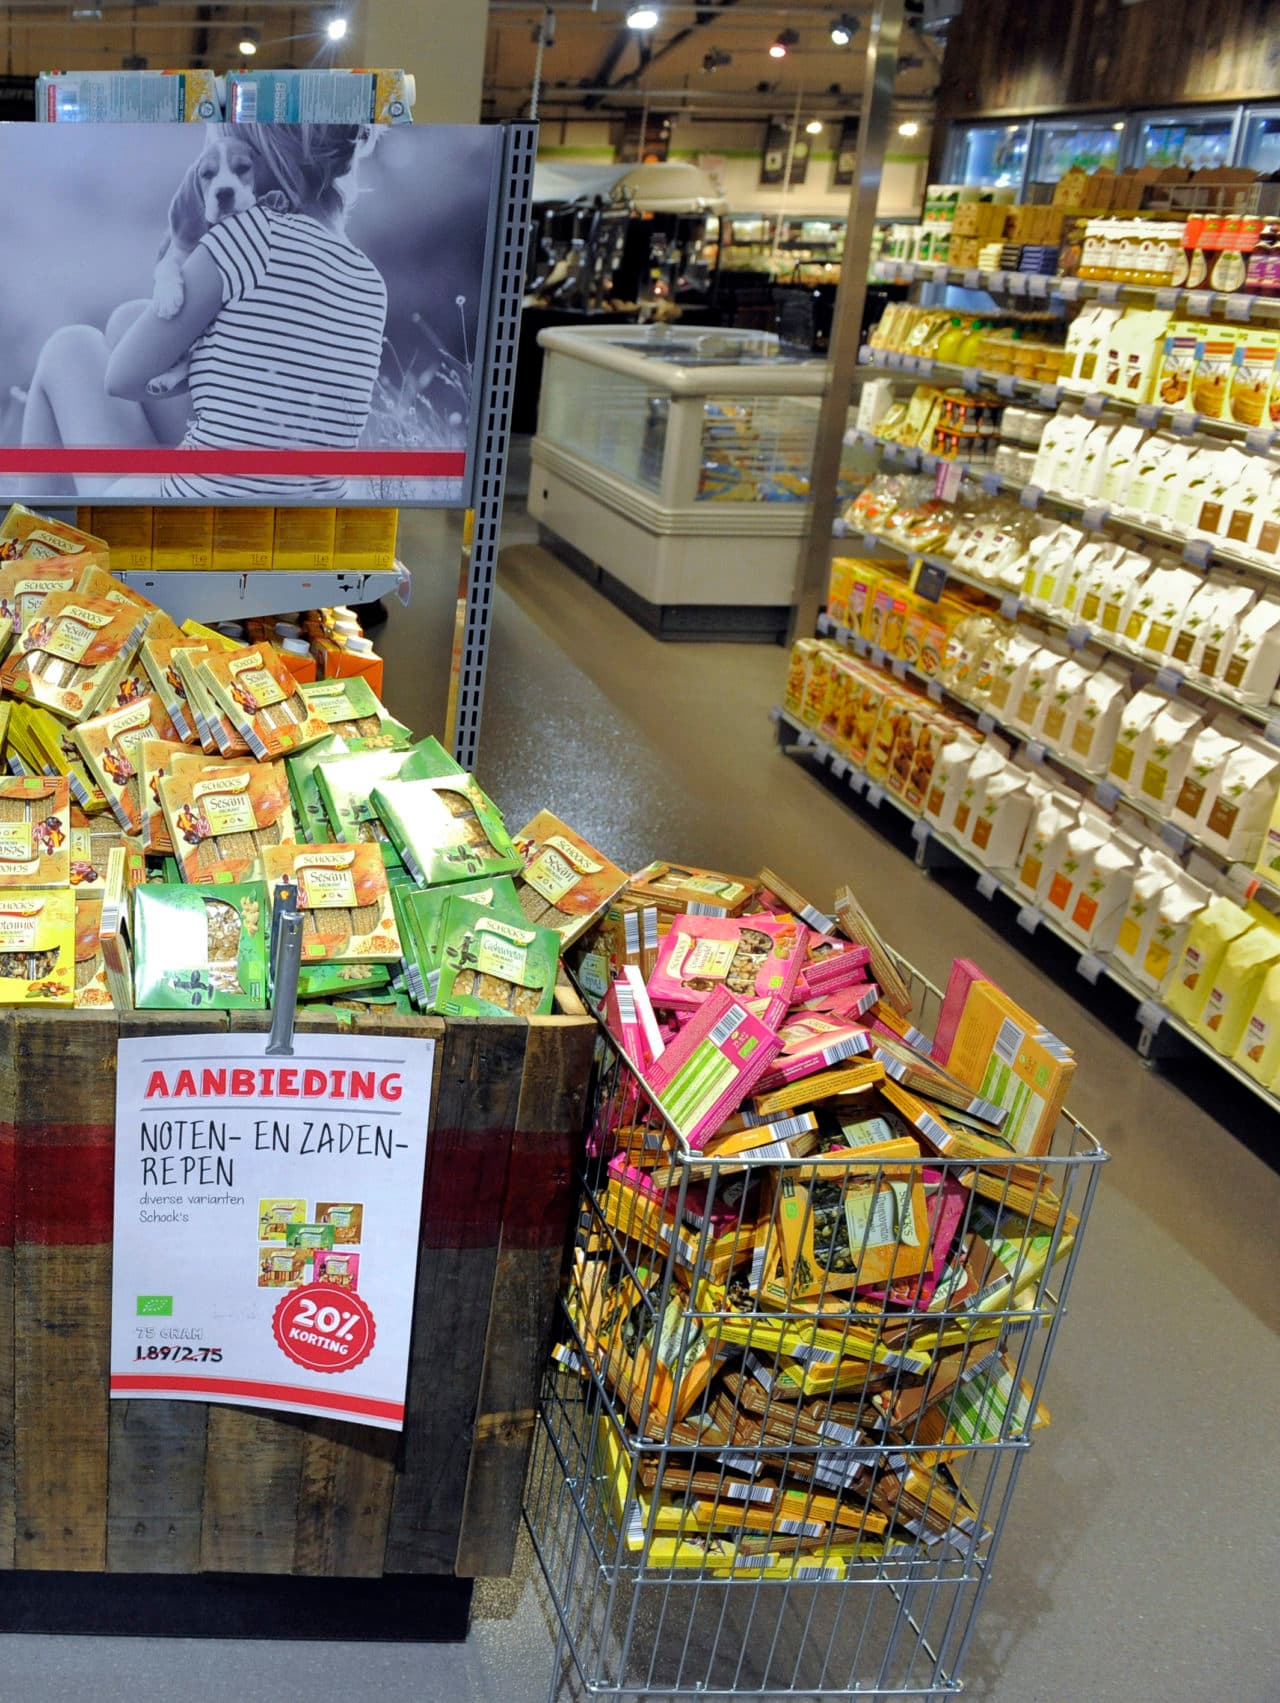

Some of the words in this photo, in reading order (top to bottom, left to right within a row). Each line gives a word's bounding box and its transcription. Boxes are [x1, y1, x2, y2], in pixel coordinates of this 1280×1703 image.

[24, 582, 65, 591] SCHOCK'S
[201, 778, 244, 792] SCHOCK'S
[210, 796, 246, 810] Sesam
[303, 854, 346, 864] SCHOCK'S
[310, 871, 348, 883] Sesam
[144, 1068, 403, 1101] AANBIEDING
[140, 1120, 242, 1152] NOTEN-
[254, 1120, 290, 1151] EN
[300, 1121, 409, 1159] ZADEN-
[141, 1156, 233, 1187] REPEN
[139, 1192, 184, 1205] diverse
[188, 1192, 245, 1205] varianten
[139, 1209, 189, 1223] Schock's
[293, 1299, 360, 1341] 20%
[136, 1327, 156, 1339] 75
[160, 1327, 204, 1341] GRAM
[289, 1328, 349, 1356] KORTING
